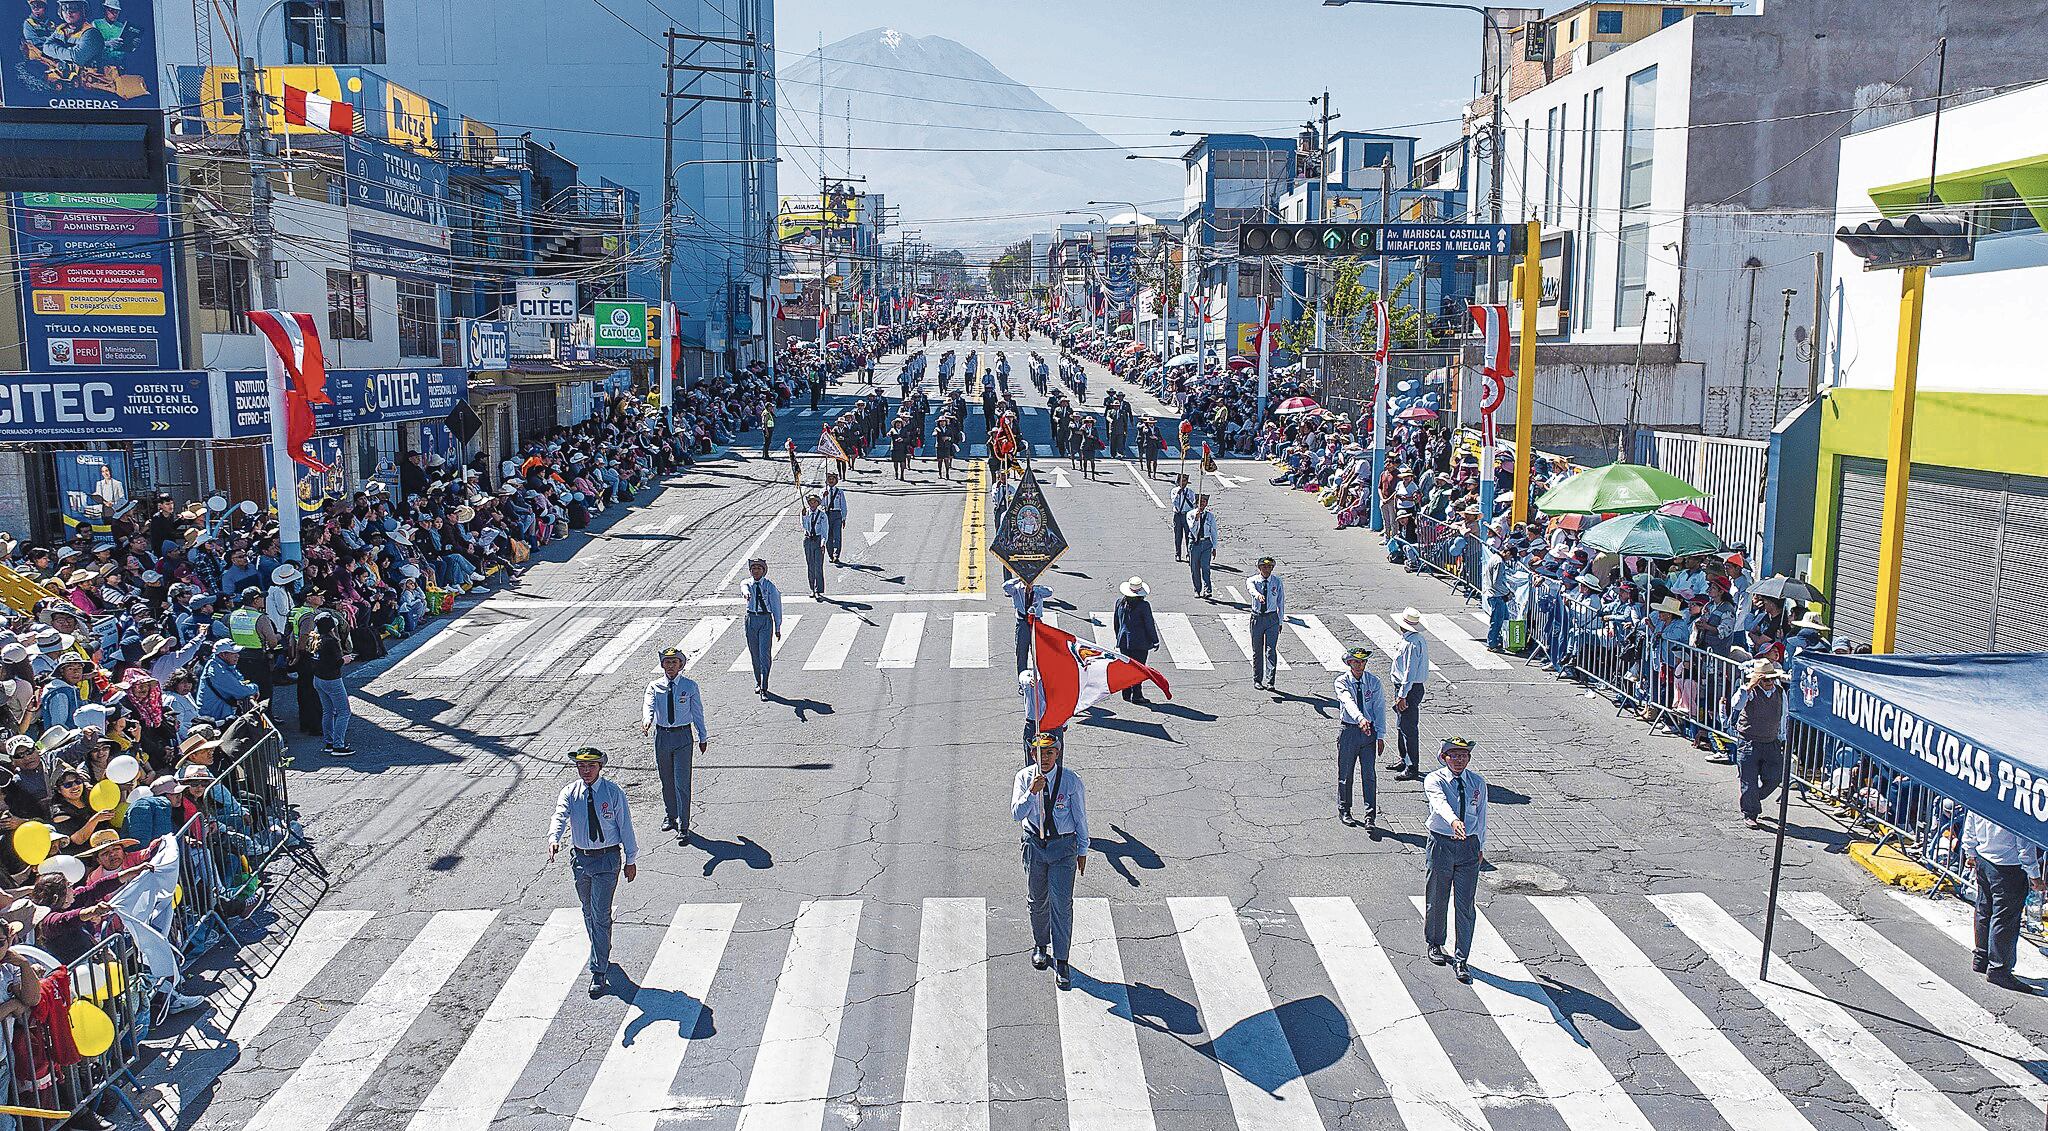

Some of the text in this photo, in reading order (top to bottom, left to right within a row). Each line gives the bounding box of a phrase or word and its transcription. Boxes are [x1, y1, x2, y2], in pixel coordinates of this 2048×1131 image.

[50, 99, 118, 109] CARRERAS
[68, 196, 120, 204] INDUSTRIAL
[1387, 229, 1490, 239] Av. MARISCAL CASTILLA
[1387, 241, 1441, 250] MIRAFLORES
[520, 300, 573, 315] CITEC
[45, 323, 81, 332] TÍTULO
[482, 333, 506, 359] CITEC
[76, 347, 98, 357] PERÚ
[235, 380, 265, 393] INSTITUTO
[376, 372, 420, 408] CITEC
[0, 383, 114, 423] CITEC
[128, 393, 162, 403] TÍTULO
[182, 395, 193, 403] EL
[123, 406, 153, 414] NIVEL
[1832, 680, 1992, 792] MUNICIPALIDAD
